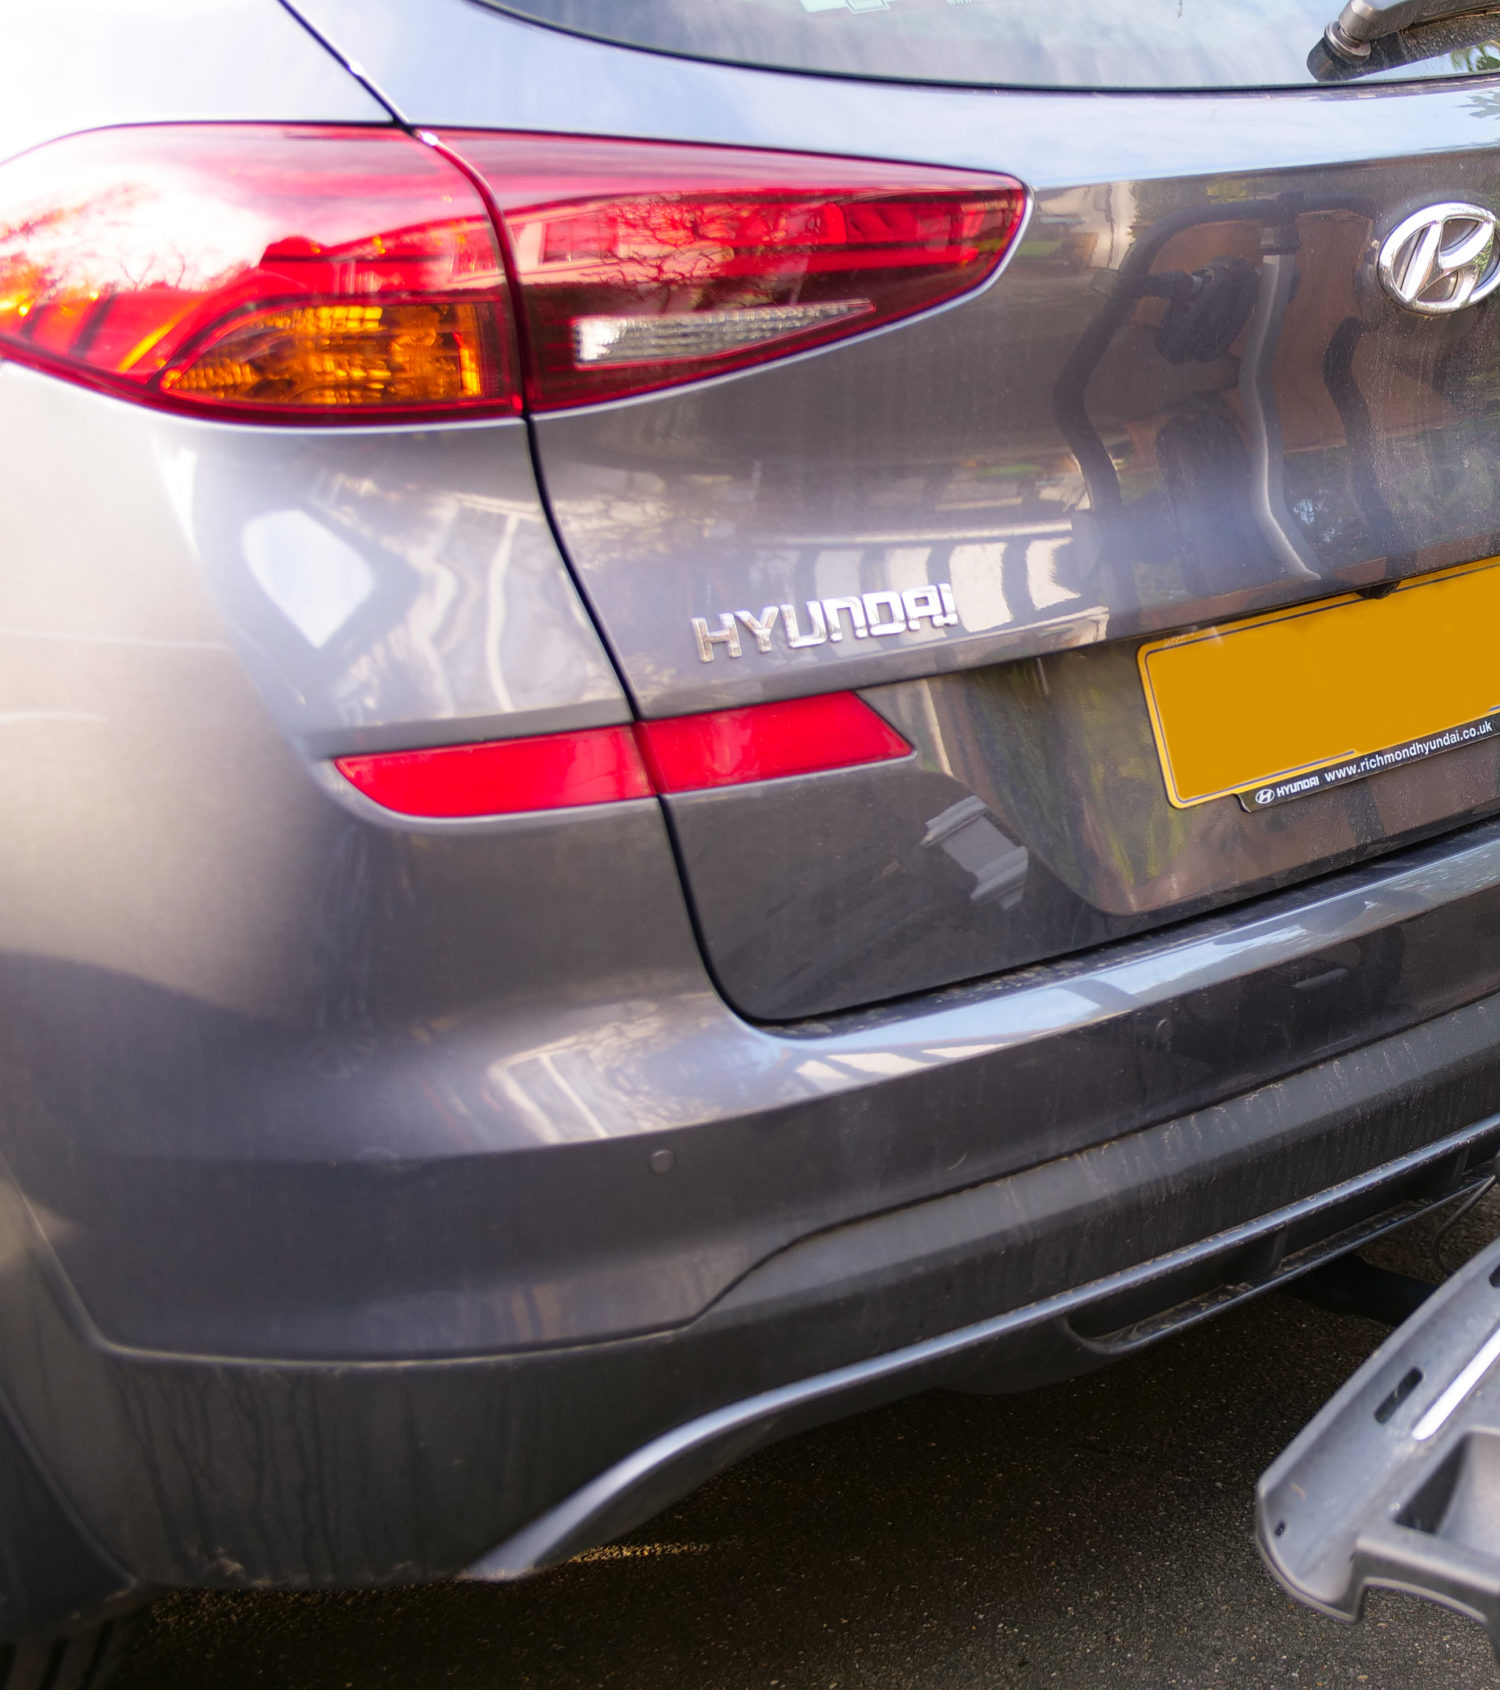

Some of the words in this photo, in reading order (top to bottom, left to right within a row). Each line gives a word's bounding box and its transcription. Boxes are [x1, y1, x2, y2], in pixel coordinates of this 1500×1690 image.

[691, 583, 958, 662] HYUNDAI
[1276, 776, 1320, 797] HYUNDAI
[1324, 720, 1493, 782] www.richmondhyundai.co.uk
